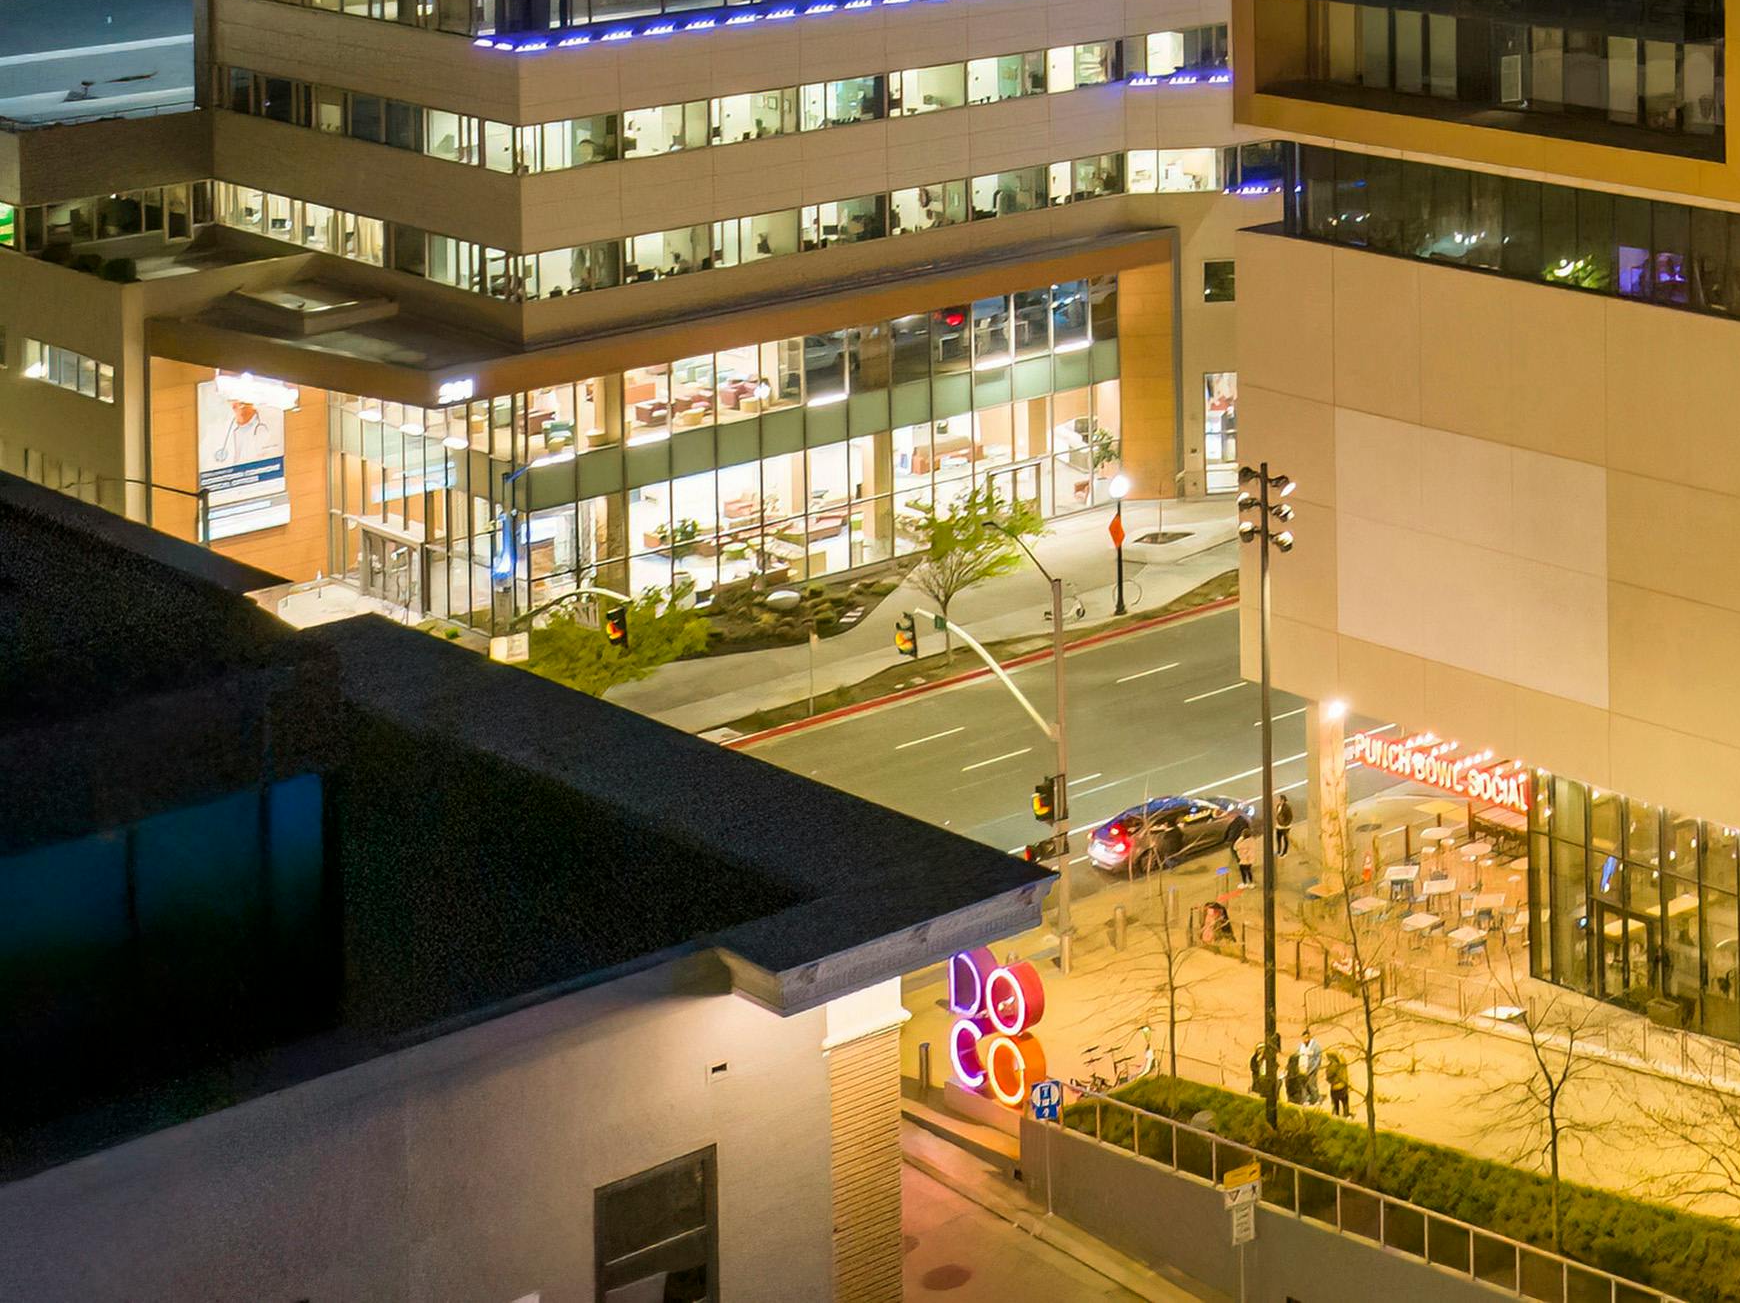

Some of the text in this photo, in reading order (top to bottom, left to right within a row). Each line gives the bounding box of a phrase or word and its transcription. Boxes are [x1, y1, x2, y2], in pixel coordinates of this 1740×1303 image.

[1355, 733, 1528, 811] PUNCH BOWL SOCIAL
